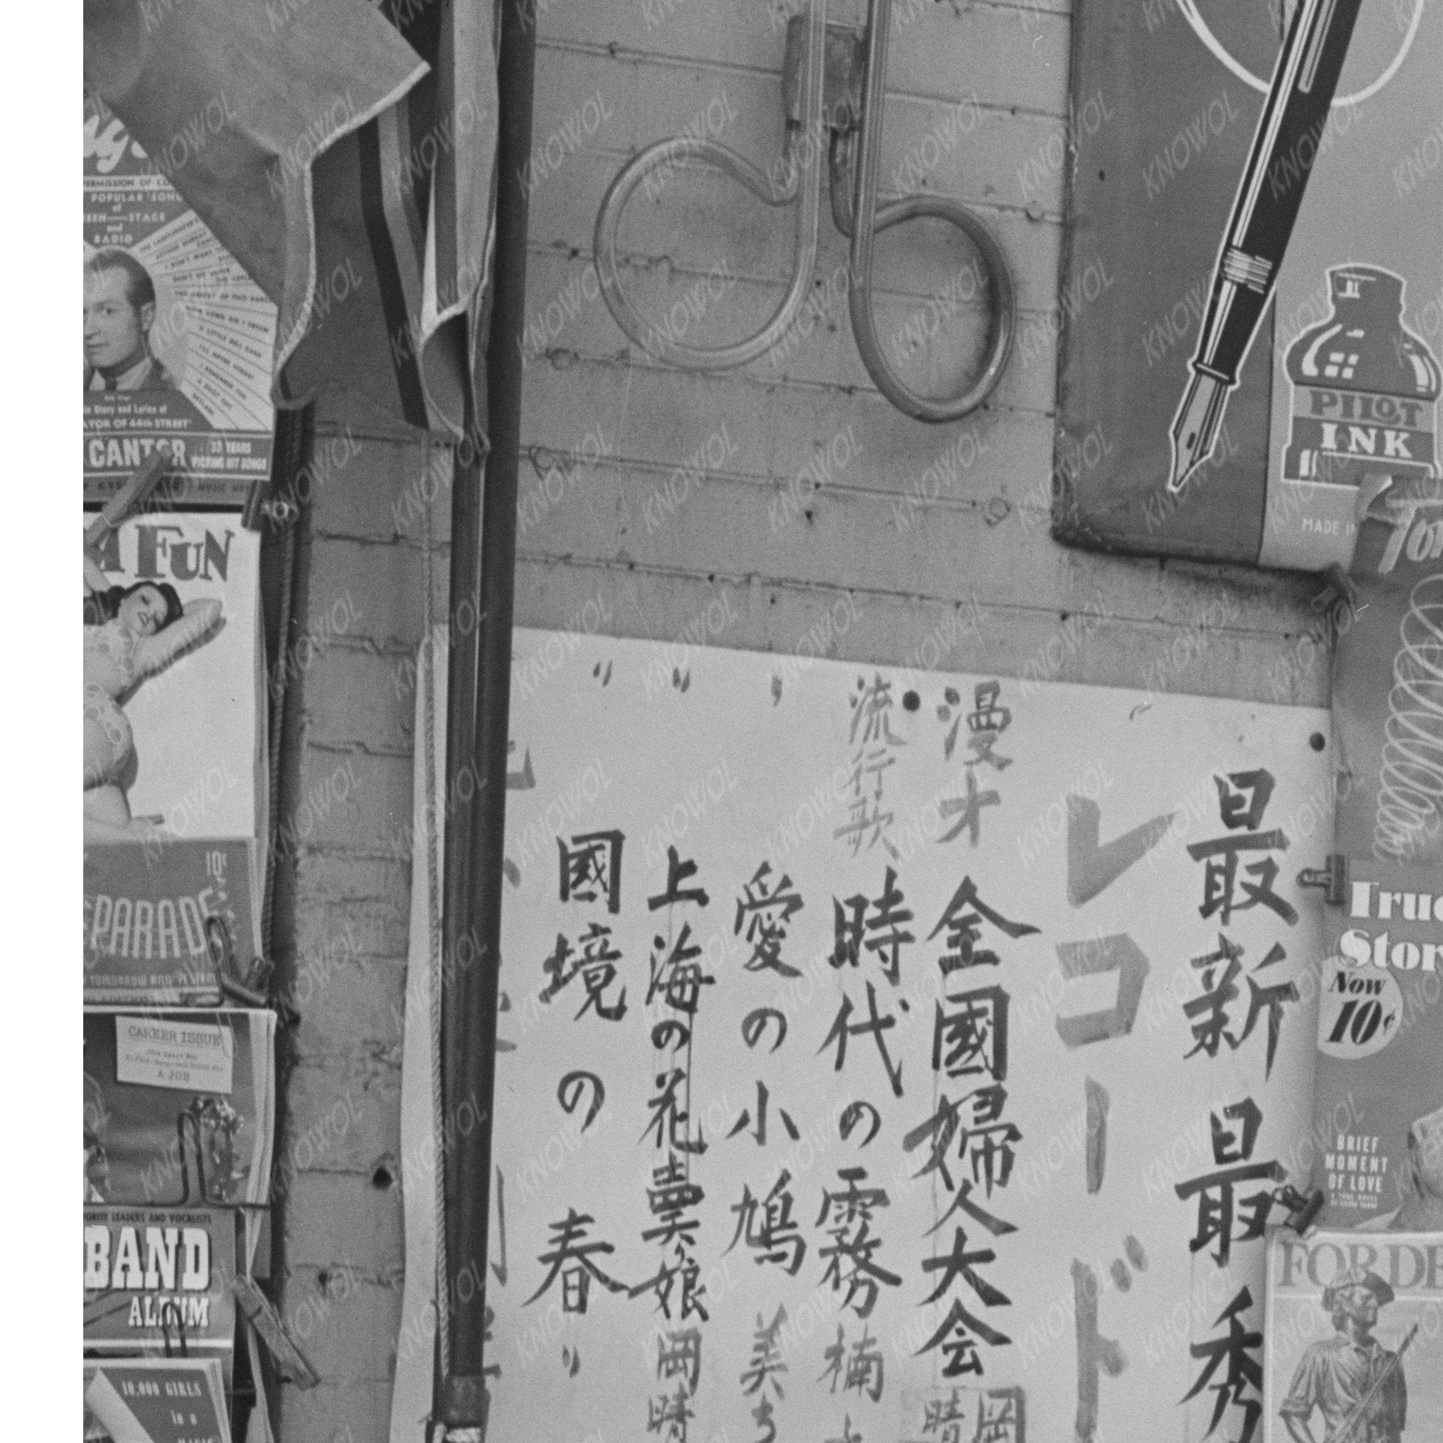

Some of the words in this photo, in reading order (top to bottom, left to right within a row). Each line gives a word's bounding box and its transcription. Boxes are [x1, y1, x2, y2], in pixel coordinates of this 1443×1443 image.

[90, 192, 143, 204] POPULAR
[128, 212, 166, 223] STAGE
[93, 234, 134, 245] RADIO
[114, 418, 127, 429] OF
[155, 418, 190, 429] STREET
[1308, 388, 1424, 429] PILOT
[89, 438, 187, 469] CANTOR
[1322, 422, 1413, 460] INK
[1301, 517, 1344, 537] MADE
[134, 523, 235, 582] FUN
[833, 671, 908, 859] 流行歌
[936, 679, 1014, 849] 漫才
[90, 887, 215, 959] PARADE
[1327, 970, 1388, 997] Now
[127, 1025, 178, 1044] CAREER
[181, 1030, 222, 1047] ISSUE
[520, 828, 631, 1315] 國境の春
[719, 860, 808, 1275] 愛の小鳩
[818, 864, 916, 1319] 時代の霧
[1337, 1134, 1380, 1154] BRIEF
[1325, 1155, 1389, 1174] MOMENT
[1328, 1174, 1345, 1191] OF
[1349, 1175, 1383, 1194] LOVE
[111, 1212, 145, 1224] LEADERS
[149, 1213, 167, 1224] AND
[169, 1213, 212, 1225] VOCALISTS
[85, 1225, 211, 1290] BAND
[1278, 1241, 1380, 1288] FOR
[128, 1295, 210, 1328] ALBUM
[165, 1381, 202, 1397] GIRLS
